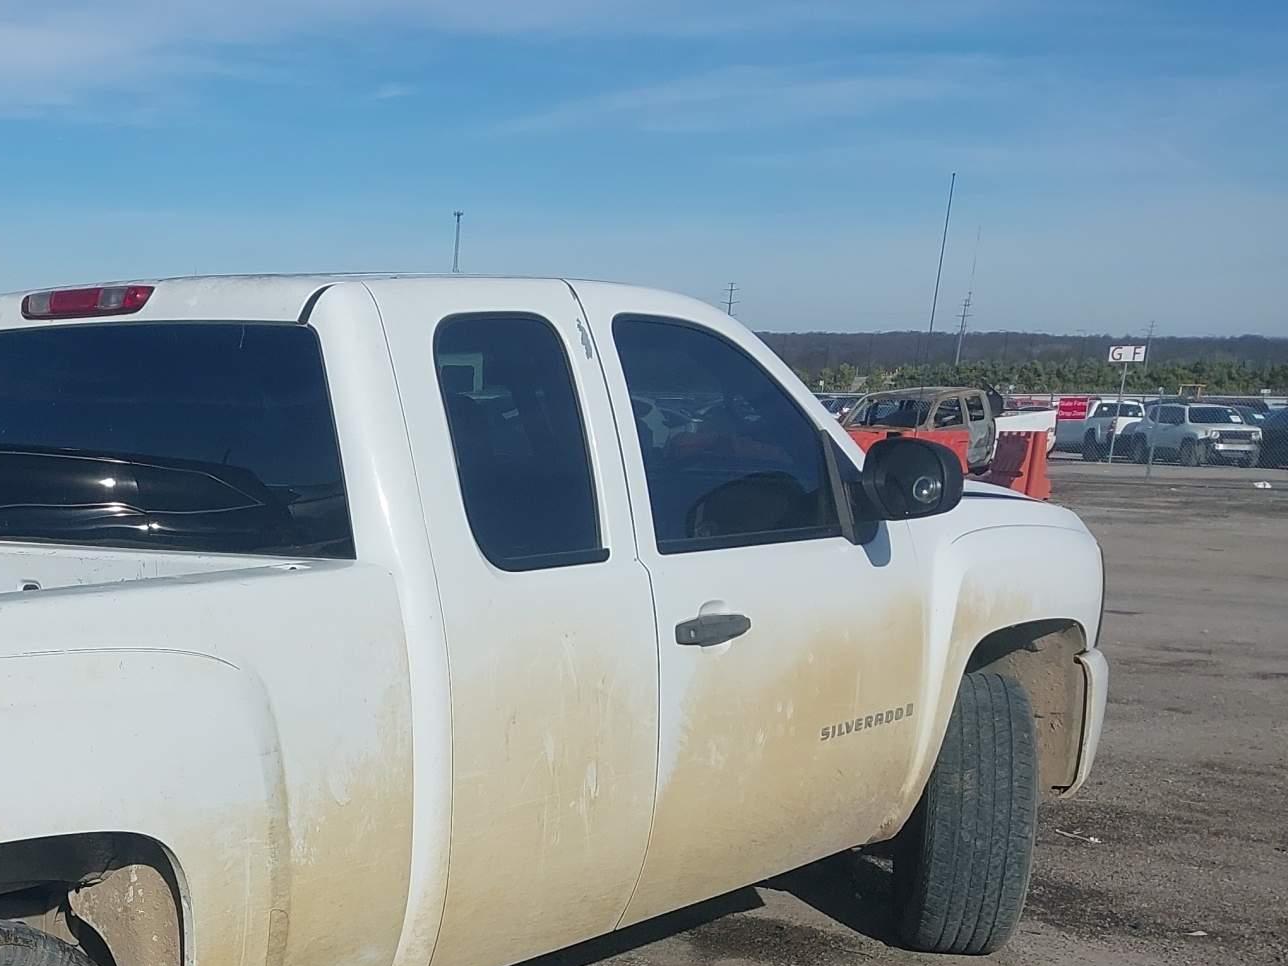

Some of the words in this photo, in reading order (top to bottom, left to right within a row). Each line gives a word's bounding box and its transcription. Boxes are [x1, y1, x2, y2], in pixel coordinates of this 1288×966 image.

[1112, 346, 1123, 360] G
[1132, 346, 1143, 360] F
[820, 707, 904, 741] SILVERADO
